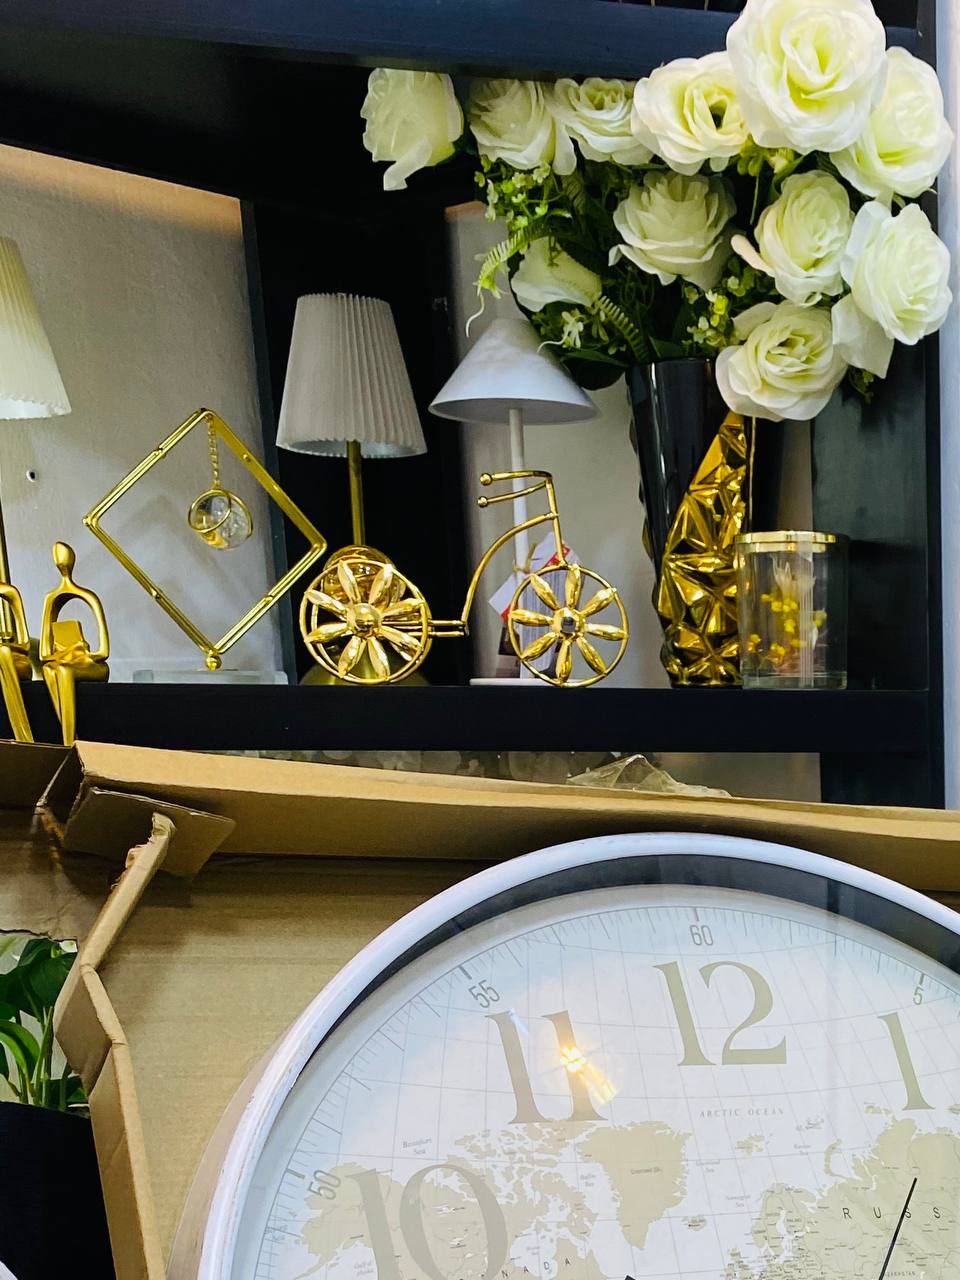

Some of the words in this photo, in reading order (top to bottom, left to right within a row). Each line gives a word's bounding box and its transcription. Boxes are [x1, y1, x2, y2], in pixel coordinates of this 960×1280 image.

[689, 923, 715, 948] 60
[469, 980, 500, 1009] 55
[912, 986, 924, 1006] 5
[653, 960, 788, 1067] 12
[485, 1009, 609, 1125] 11
[876, 1011, 936, 1112] 1
[699, 1107, 741, 1119] ARCTIC
[747, 1107, 785, 1118] OCEAN
[307, 1169, 342, 1201] 50
